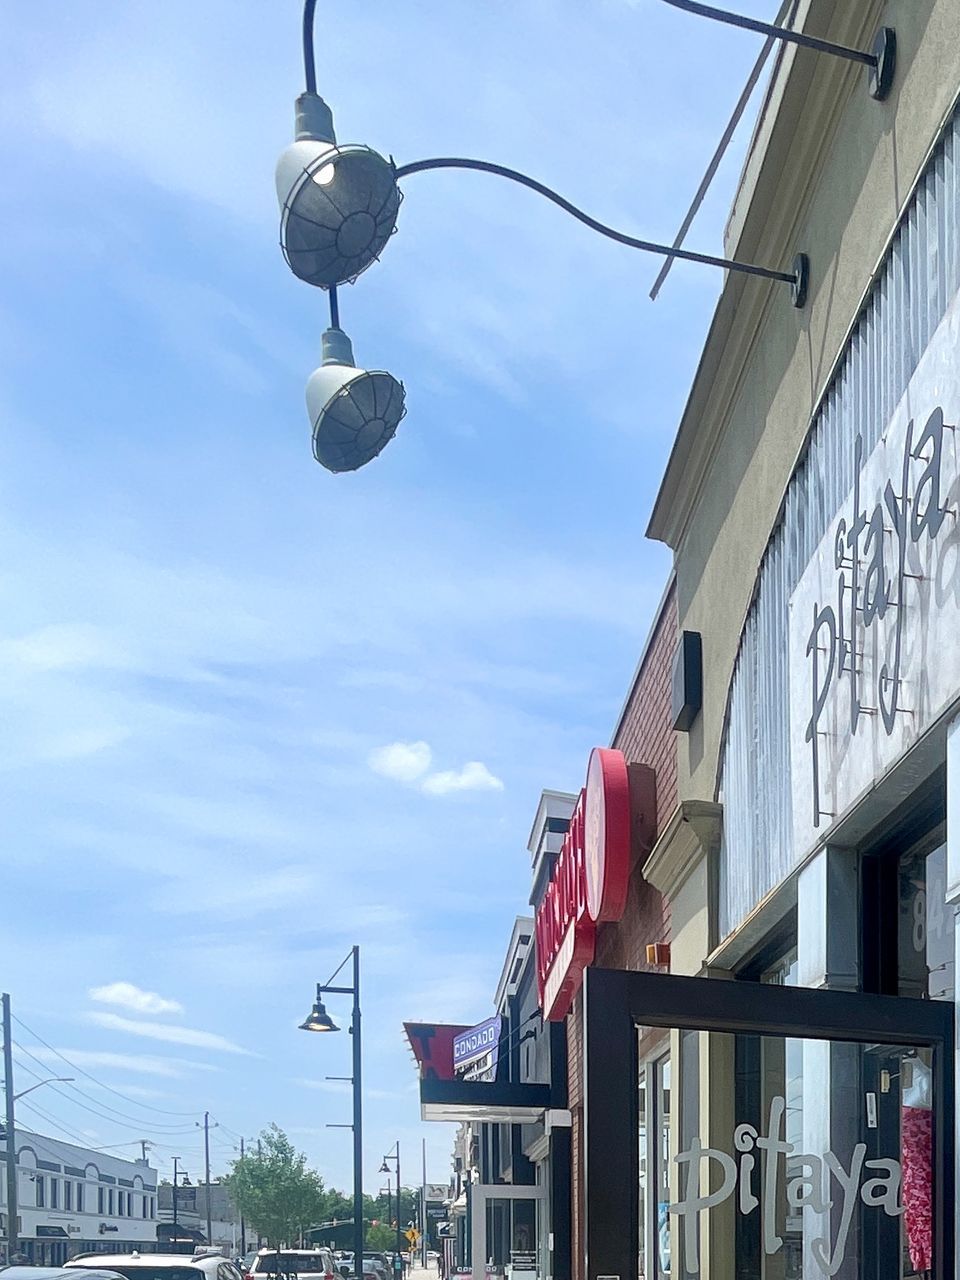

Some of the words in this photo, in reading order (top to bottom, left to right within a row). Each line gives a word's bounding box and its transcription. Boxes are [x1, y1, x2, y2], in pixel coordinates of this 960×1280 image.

[805, 406, 949, 828] pitaya
[454, 1027, 495, 1058] CONDADO
[668, 1096, 905, 1277] pitaya
